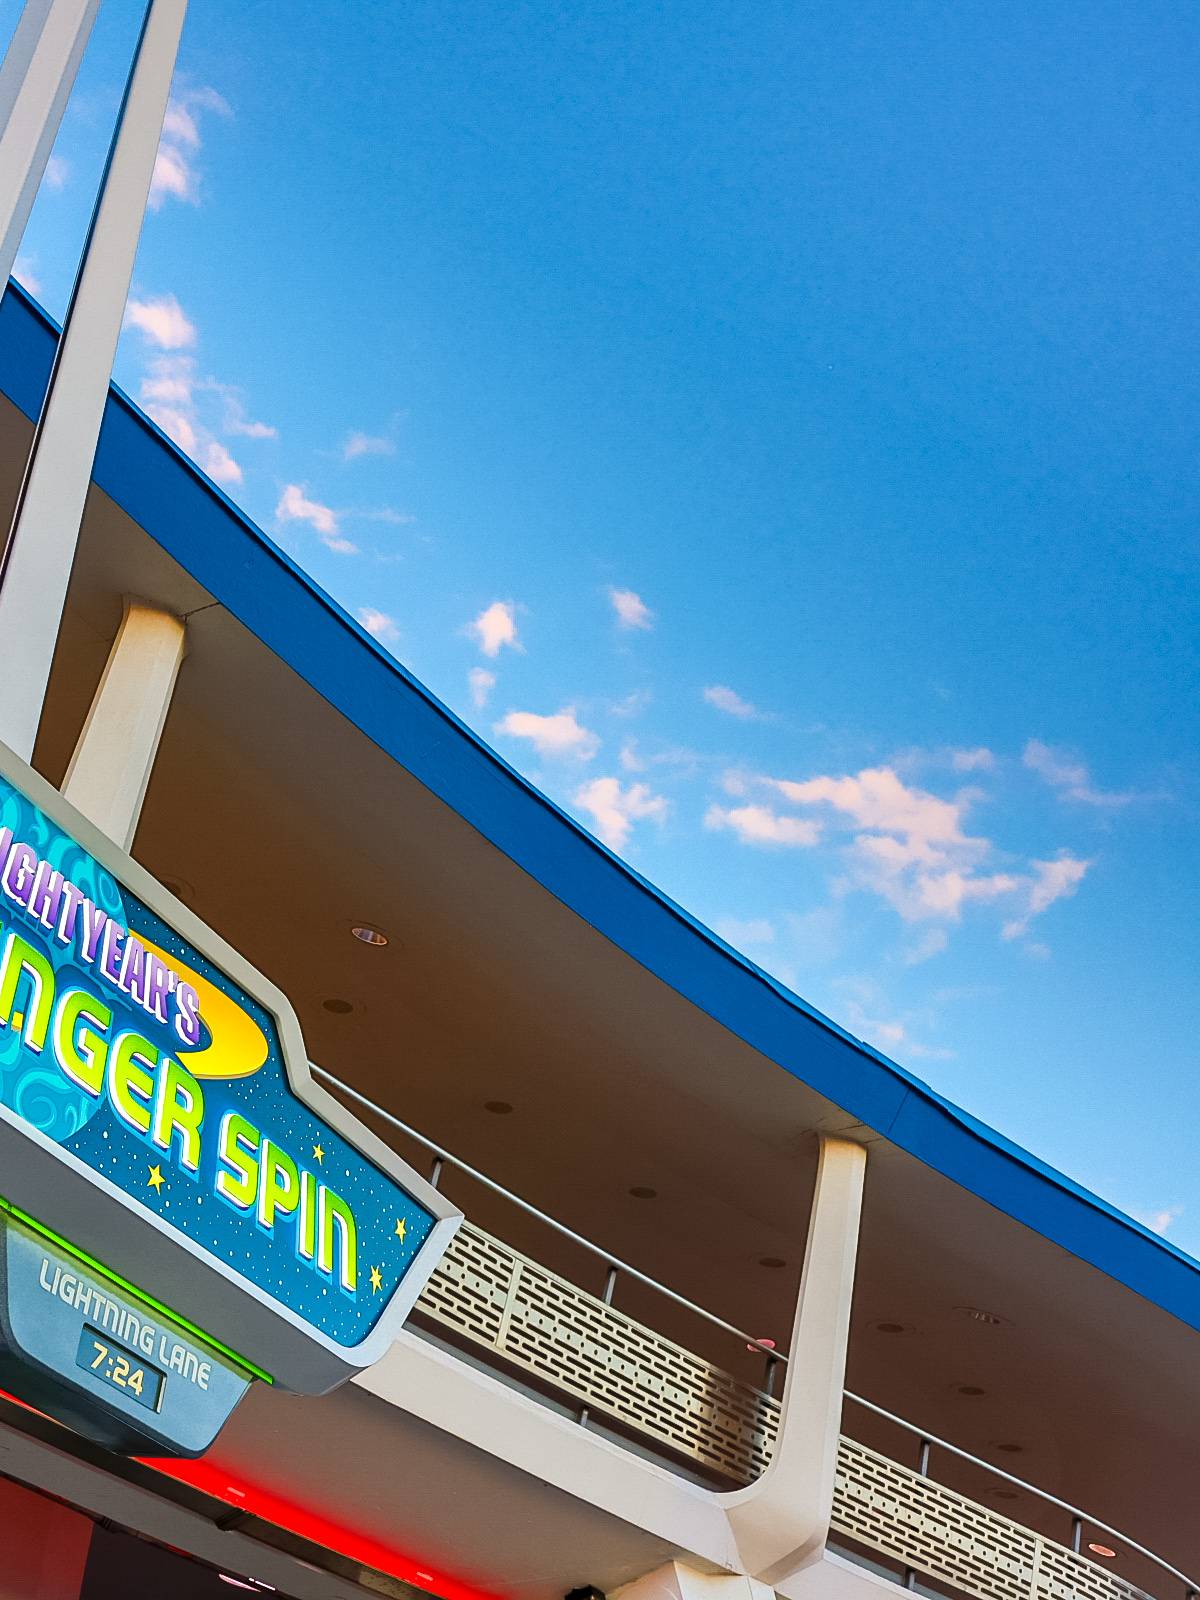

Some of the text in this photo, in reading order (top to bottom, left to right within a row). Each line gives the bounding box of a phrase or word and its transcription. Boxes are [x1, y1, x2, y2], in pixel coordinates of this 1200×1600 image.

[215, 1111, 357, 1293] SPIN
[39, 1258, 211, 1391] LIGHTNING LANE
[90, 1341, 145, 1397] 7:24
